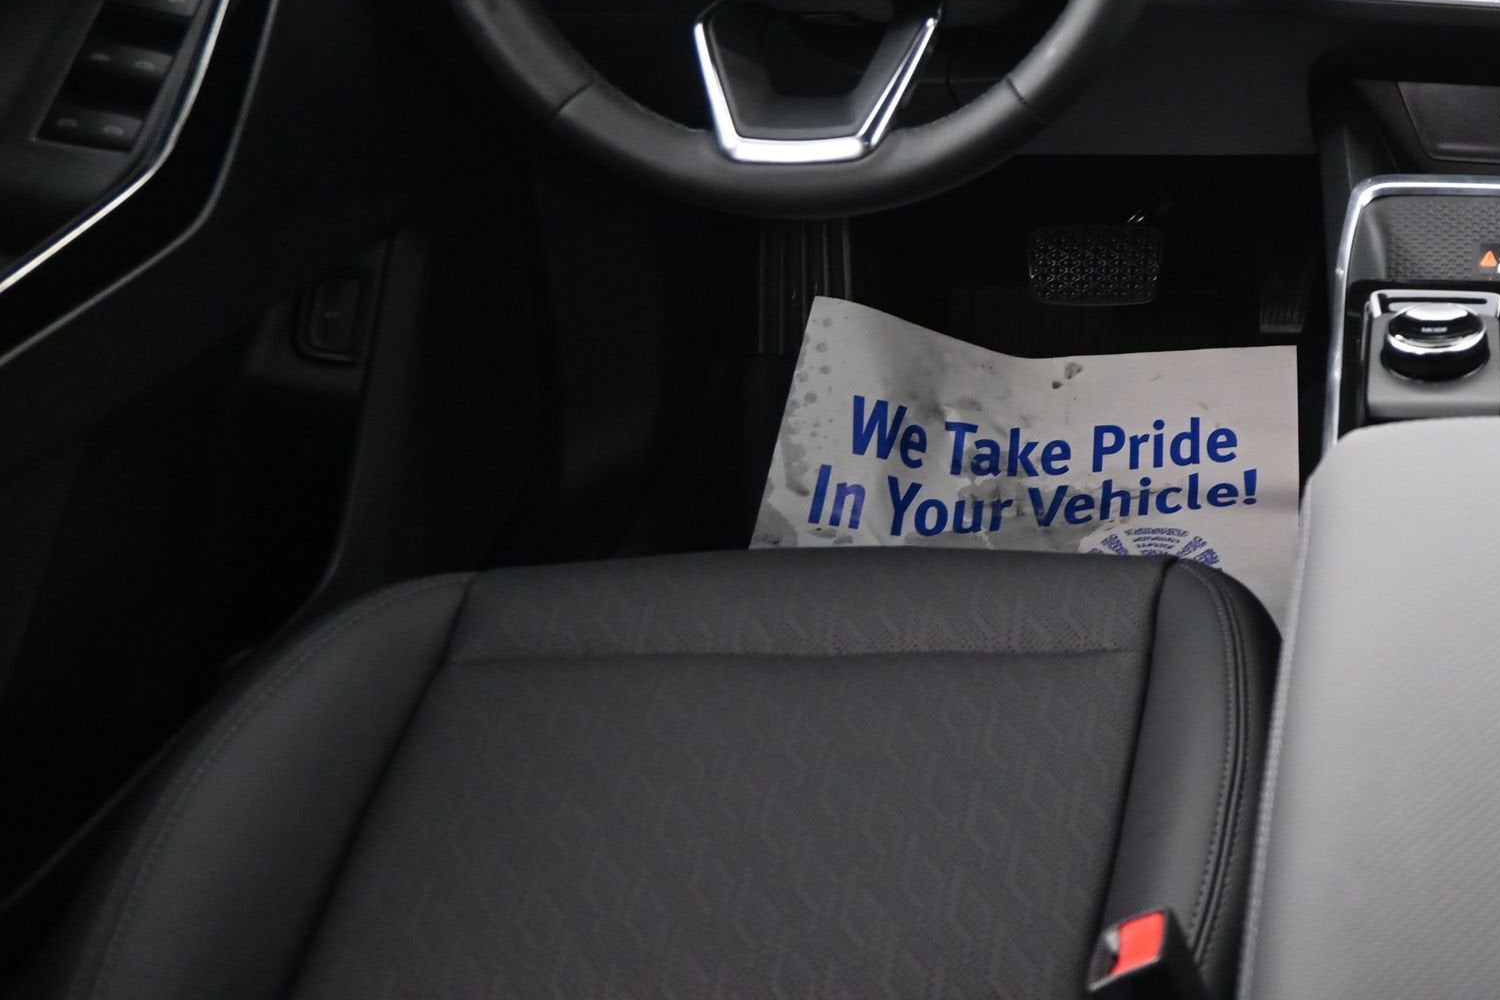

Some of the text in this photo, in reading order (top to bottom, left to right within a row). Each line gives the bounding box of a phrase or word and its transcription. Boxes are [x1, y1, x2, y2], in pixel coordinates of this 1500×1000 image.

[852, 394, 1238, 478] We Take Pride
[807, 463, 1257, 538] In Your Vehicle!
